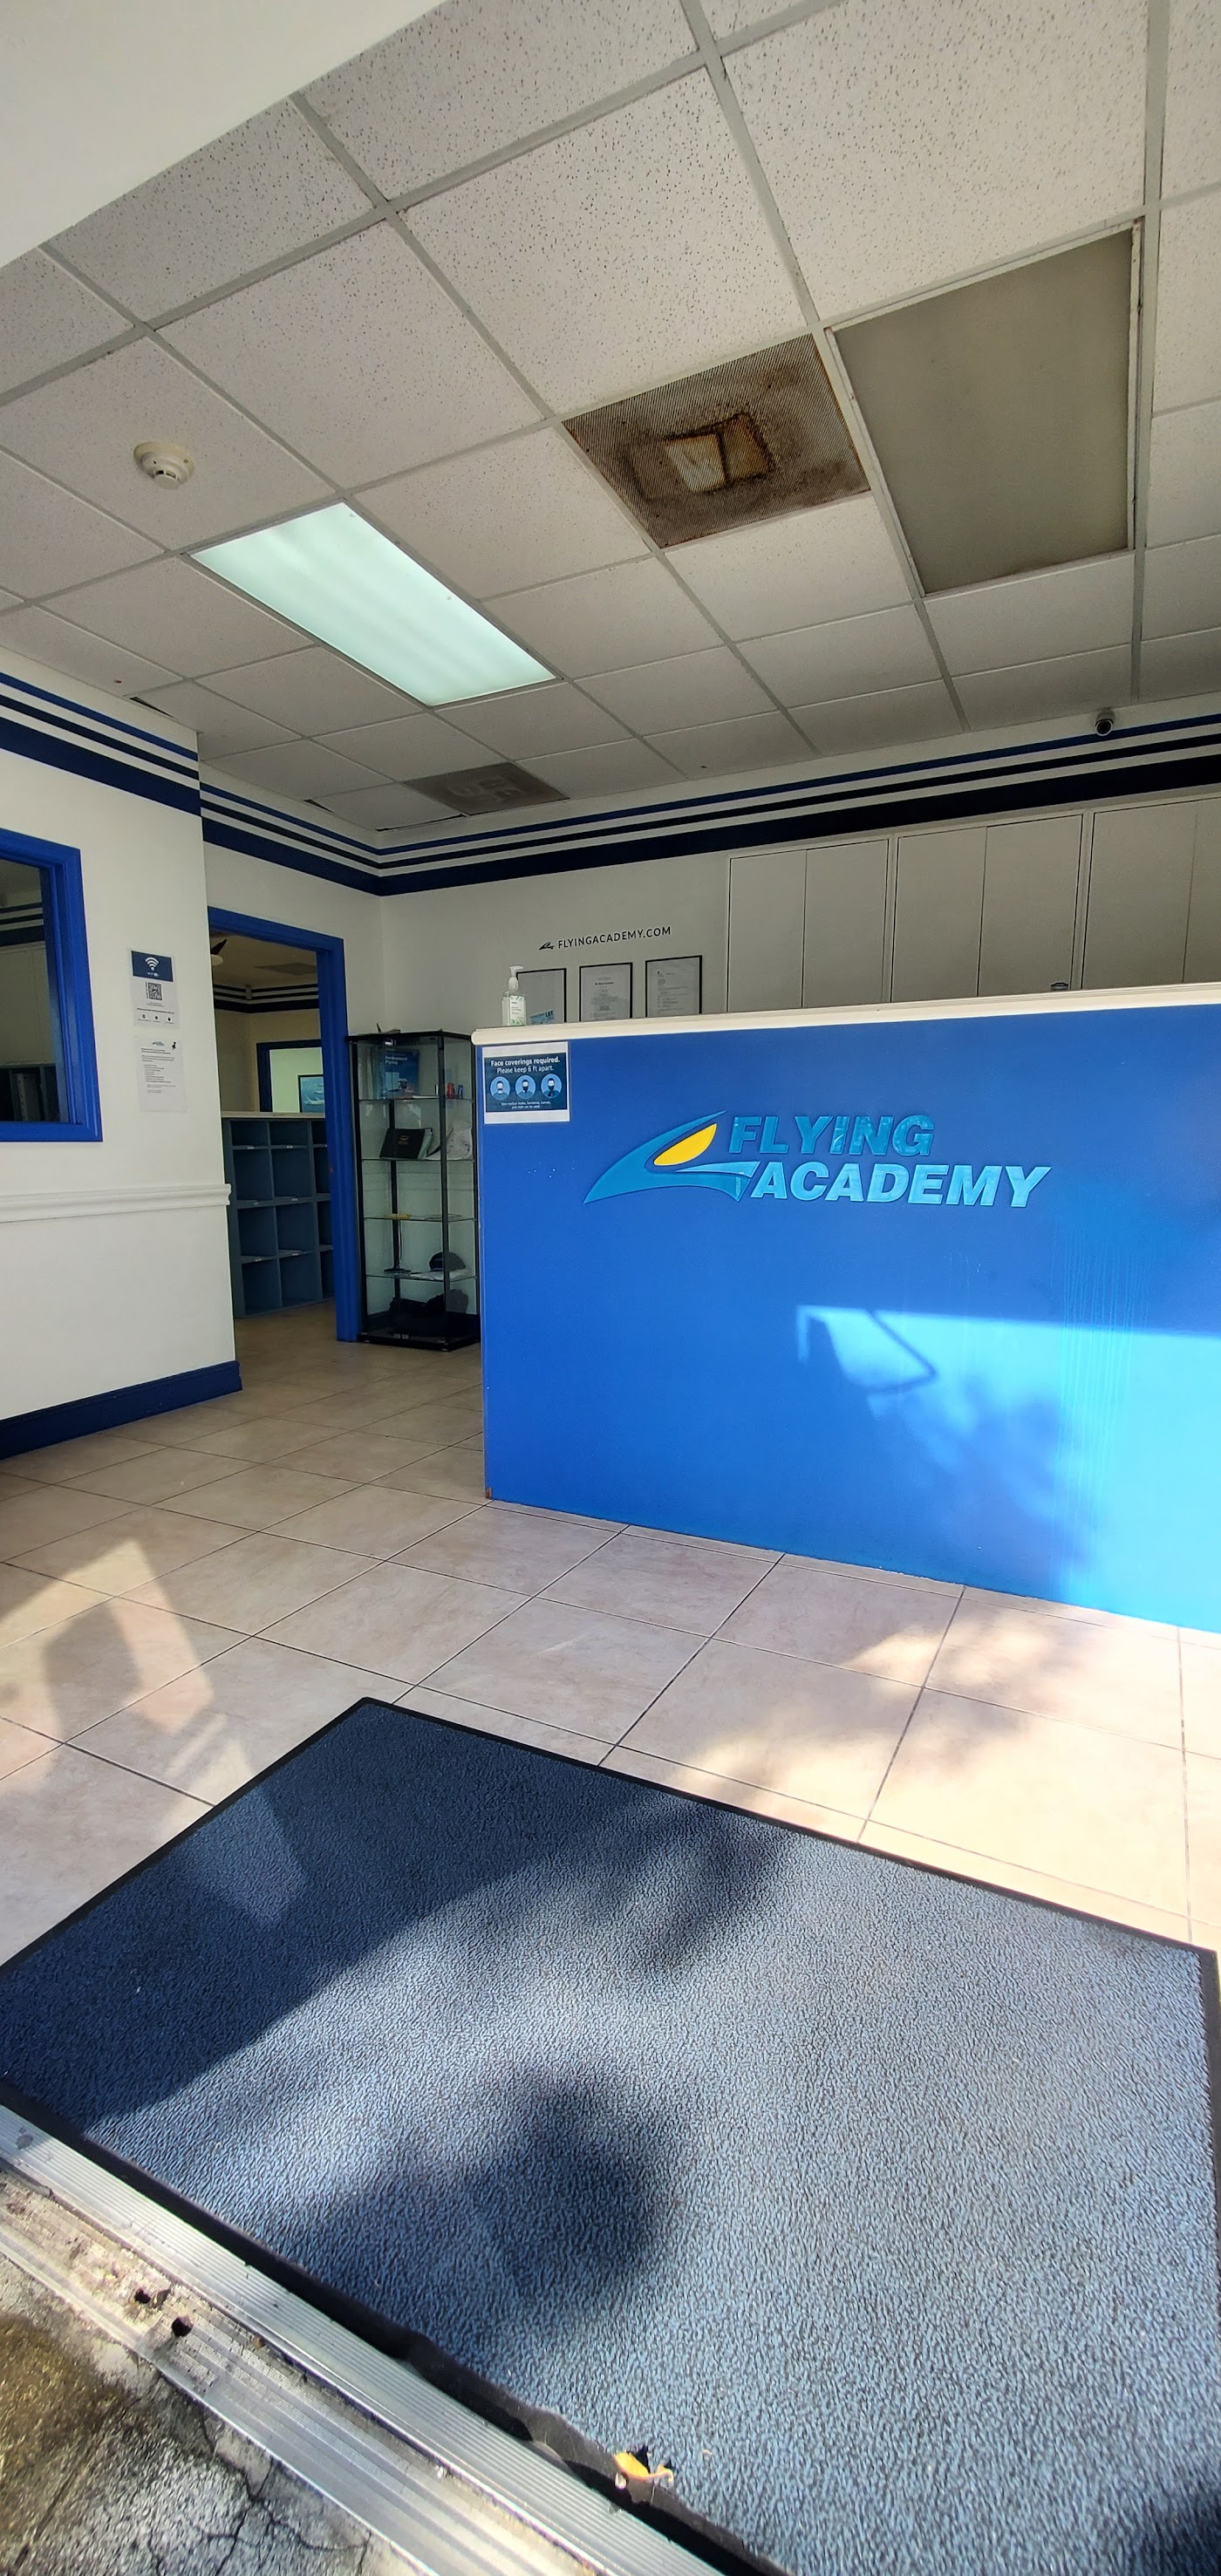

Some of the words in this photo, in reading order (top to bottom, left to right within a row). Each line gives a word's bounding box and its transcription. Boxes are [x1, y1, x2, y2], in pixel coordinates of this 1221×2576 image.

[558, 926, 671, 949] FLYINGACADEMY.COM
[533, 1056, 561, 1065] required.
[728, 1115, 935, 1156] FLYING
[750, 1161, 1052, 1208] ACADEMY
